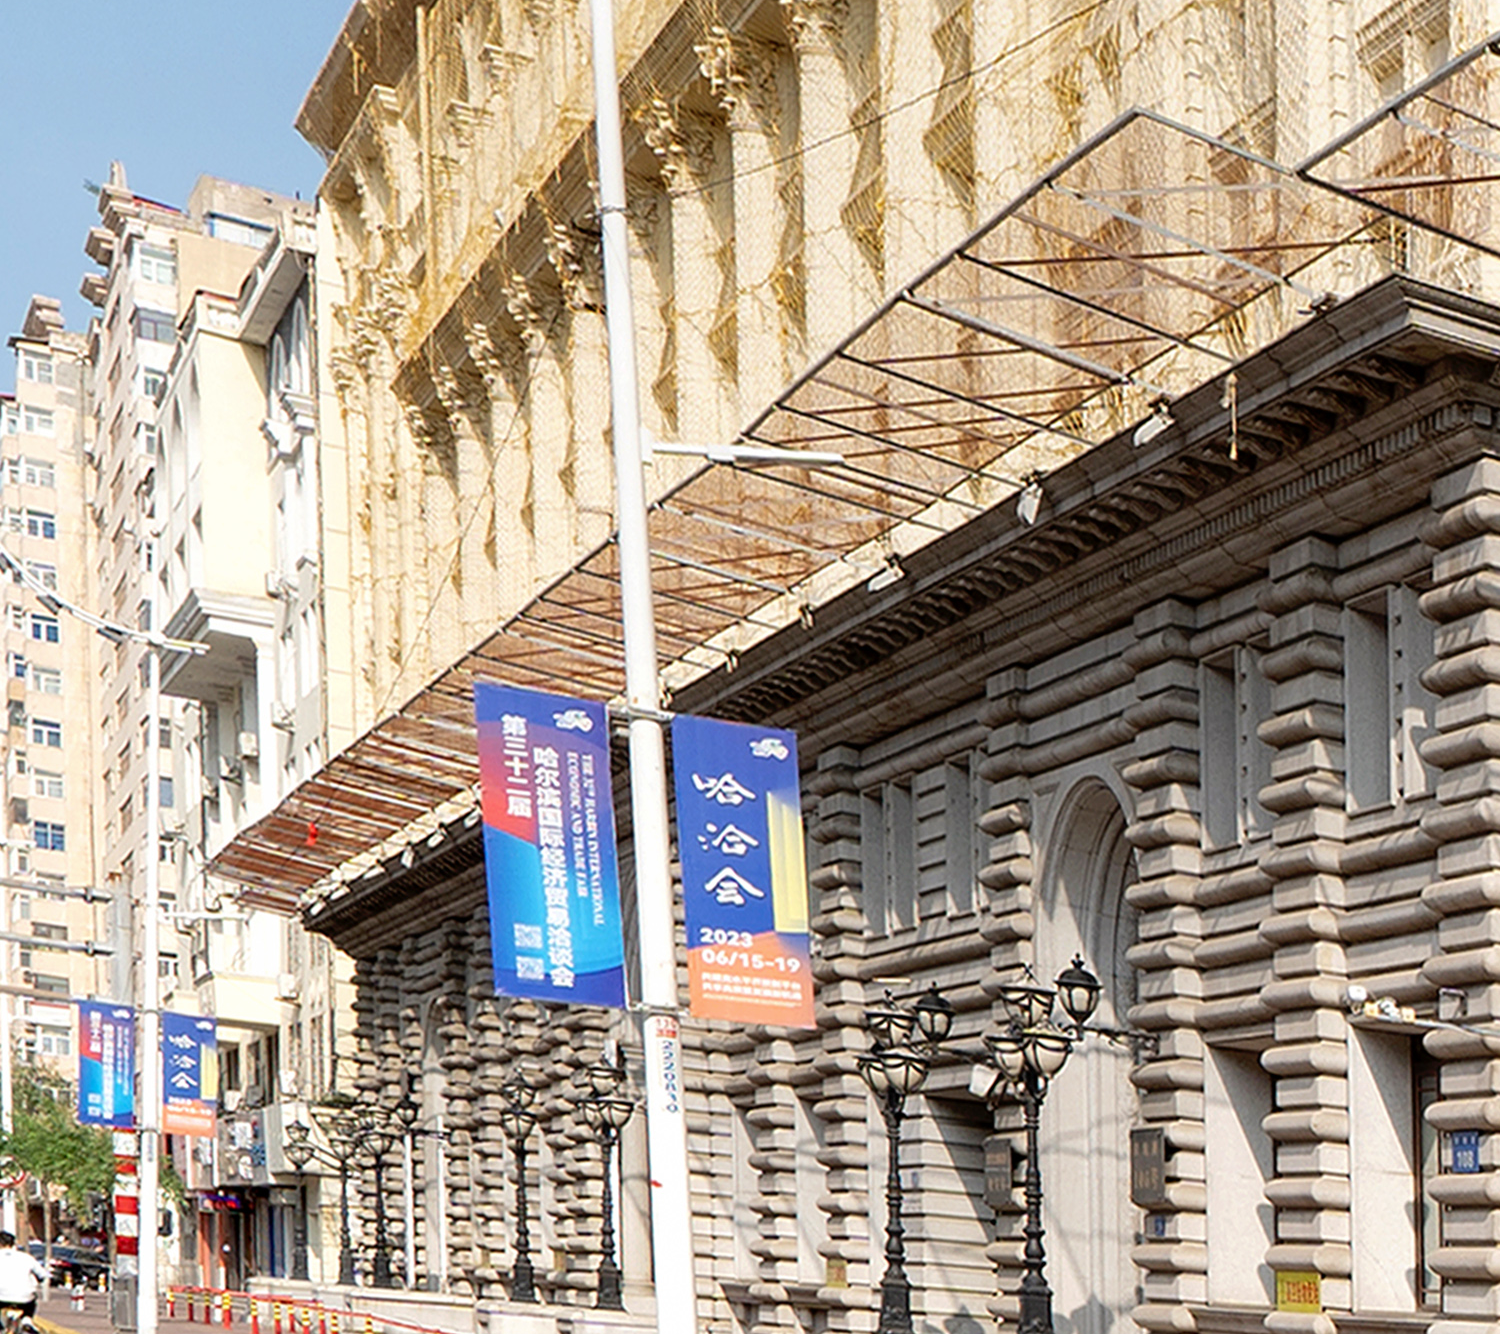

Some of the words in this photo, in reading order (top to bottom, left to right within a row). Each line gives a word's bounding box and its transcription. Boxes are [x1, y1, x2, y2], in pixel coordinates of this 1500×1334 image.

[502, 714, 533, 819] 第三十二届
[692, 773, 765, 907] 哈洽会
[700, 927, 754, 948] 2023
[701, 948, 801, 974] 06/15-19
